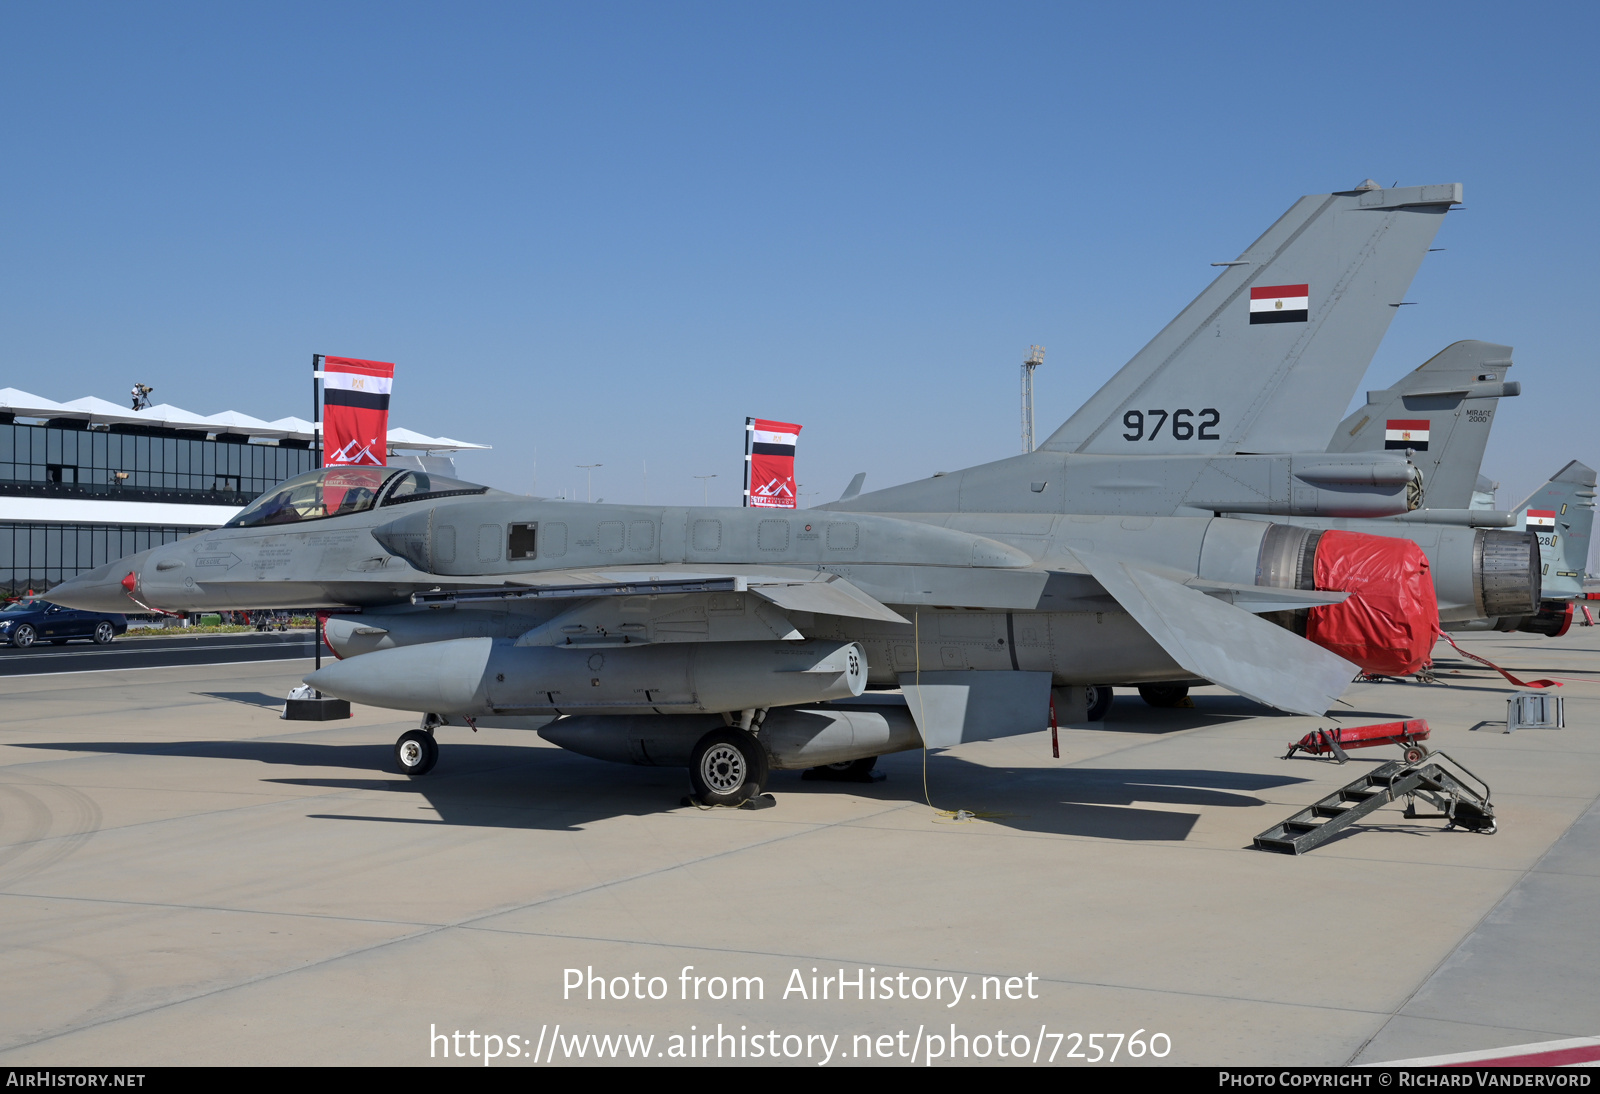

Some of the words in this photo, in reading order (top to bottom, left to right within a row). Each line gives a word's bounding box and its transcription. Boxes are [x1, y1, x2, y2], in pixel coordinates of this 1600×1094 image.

[1466, 409, 1492, 417] MIRAGE
[1468, 415, 1487, 423] 2000
[1123, 408, 1220, 441] 9762
